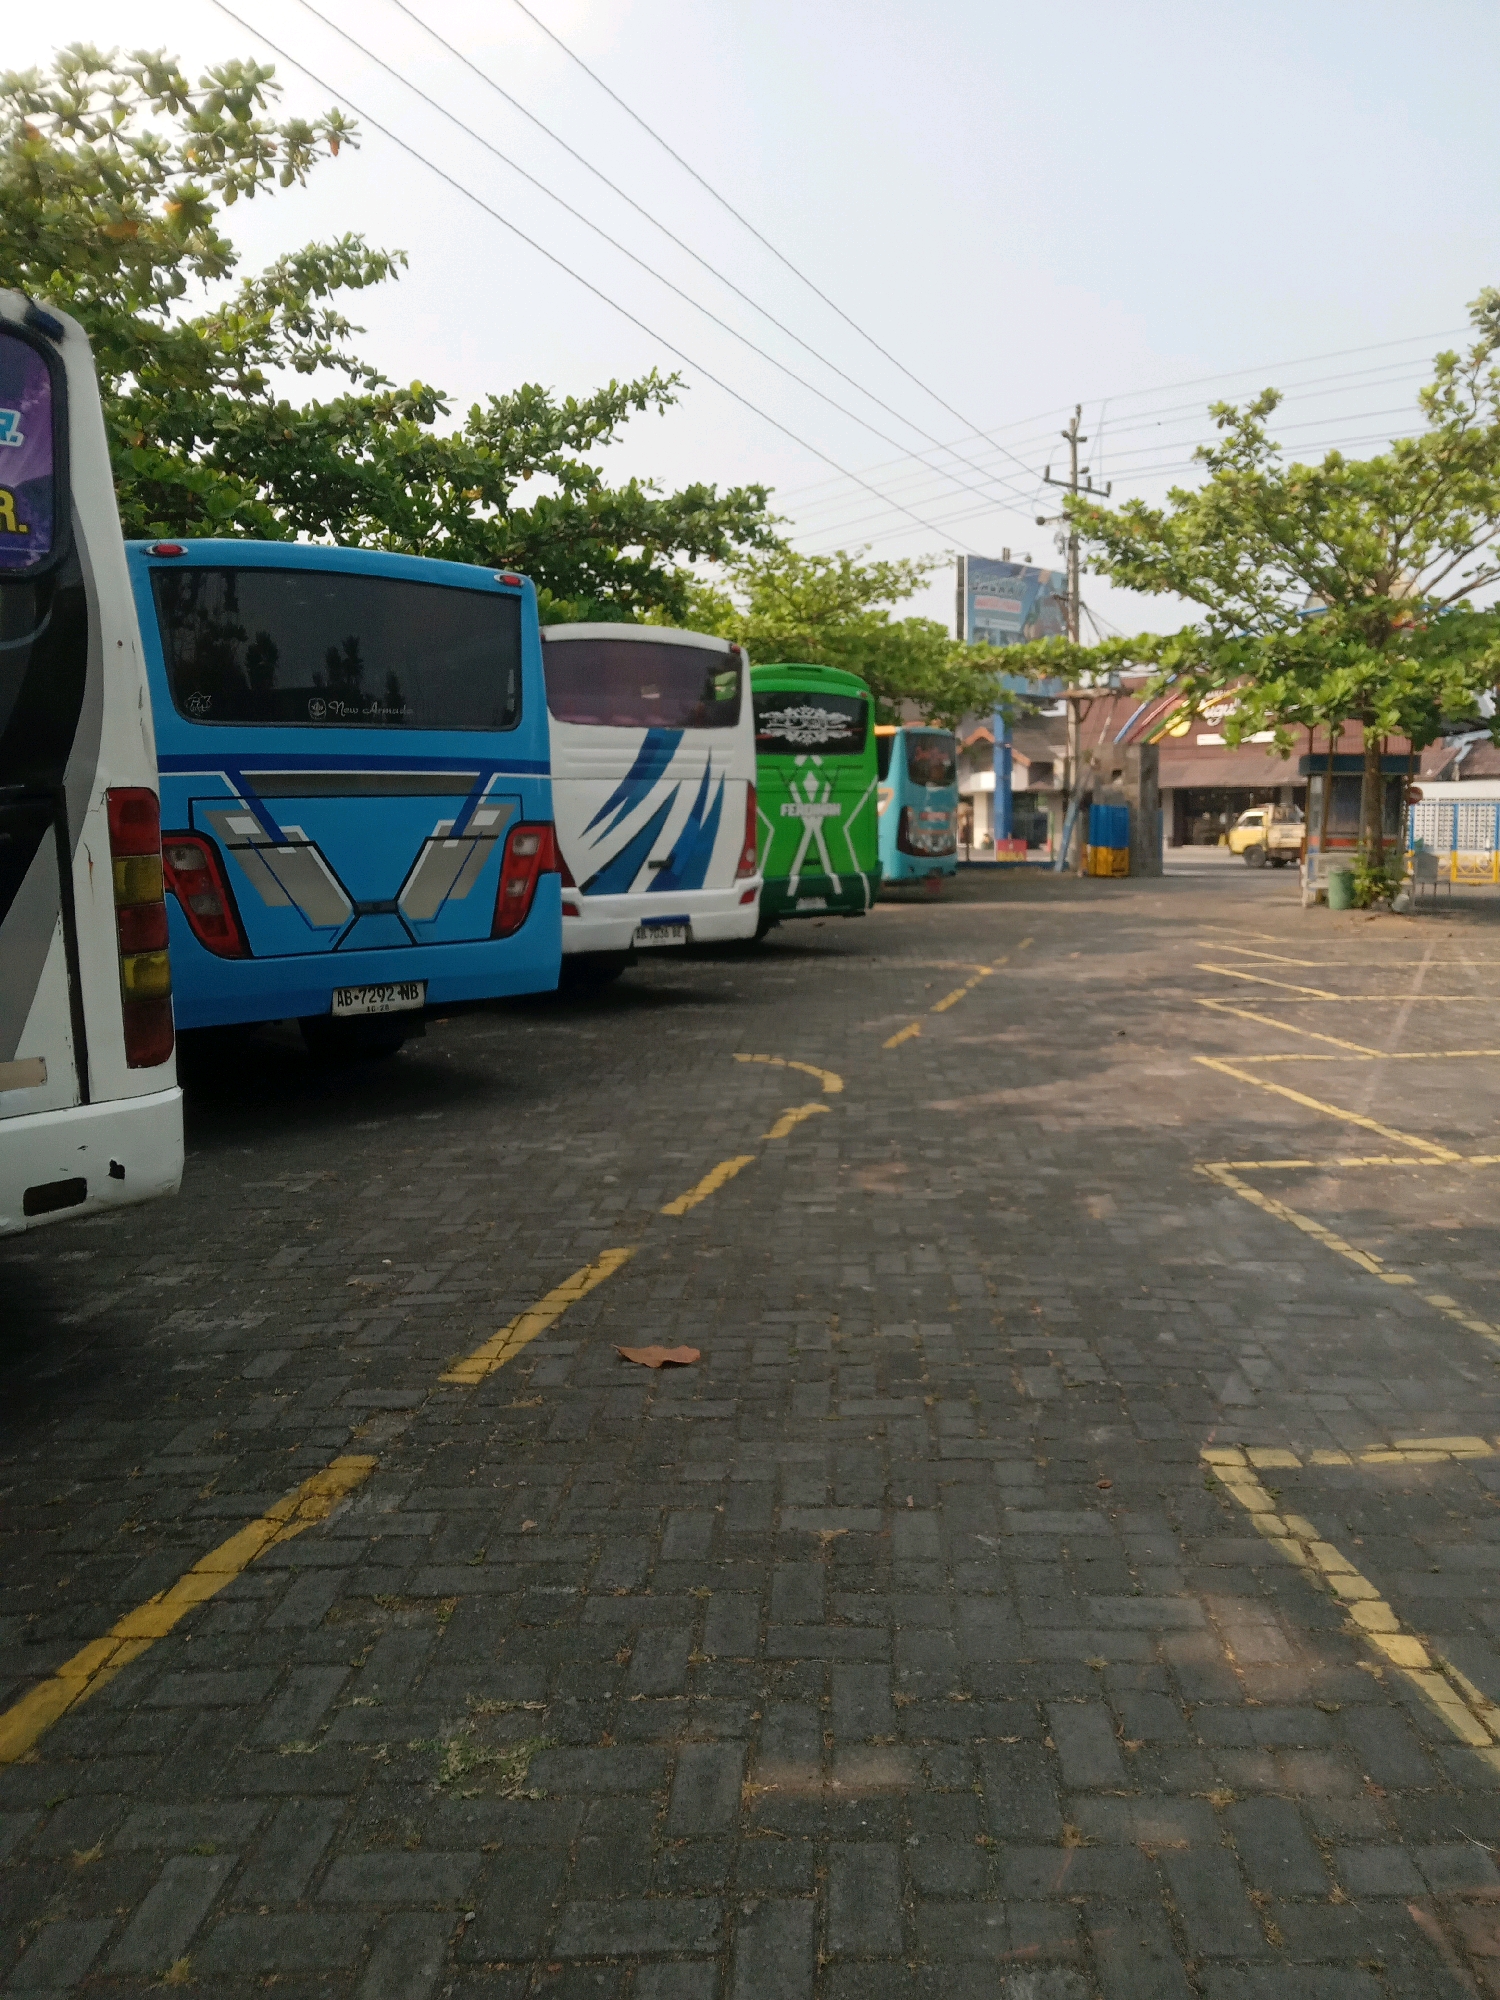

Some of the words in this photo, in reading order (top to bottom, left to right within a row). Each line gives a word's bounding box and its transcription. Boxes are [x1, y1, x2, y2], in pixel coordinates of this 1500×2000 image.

[328, 700, 359, 717] New
[362, 700, 414, 715] Armada
[337, 989, 353, 1008] AB
[359, 986, 396, 1005] 7292
[398, 983, 419, 1001] NB
